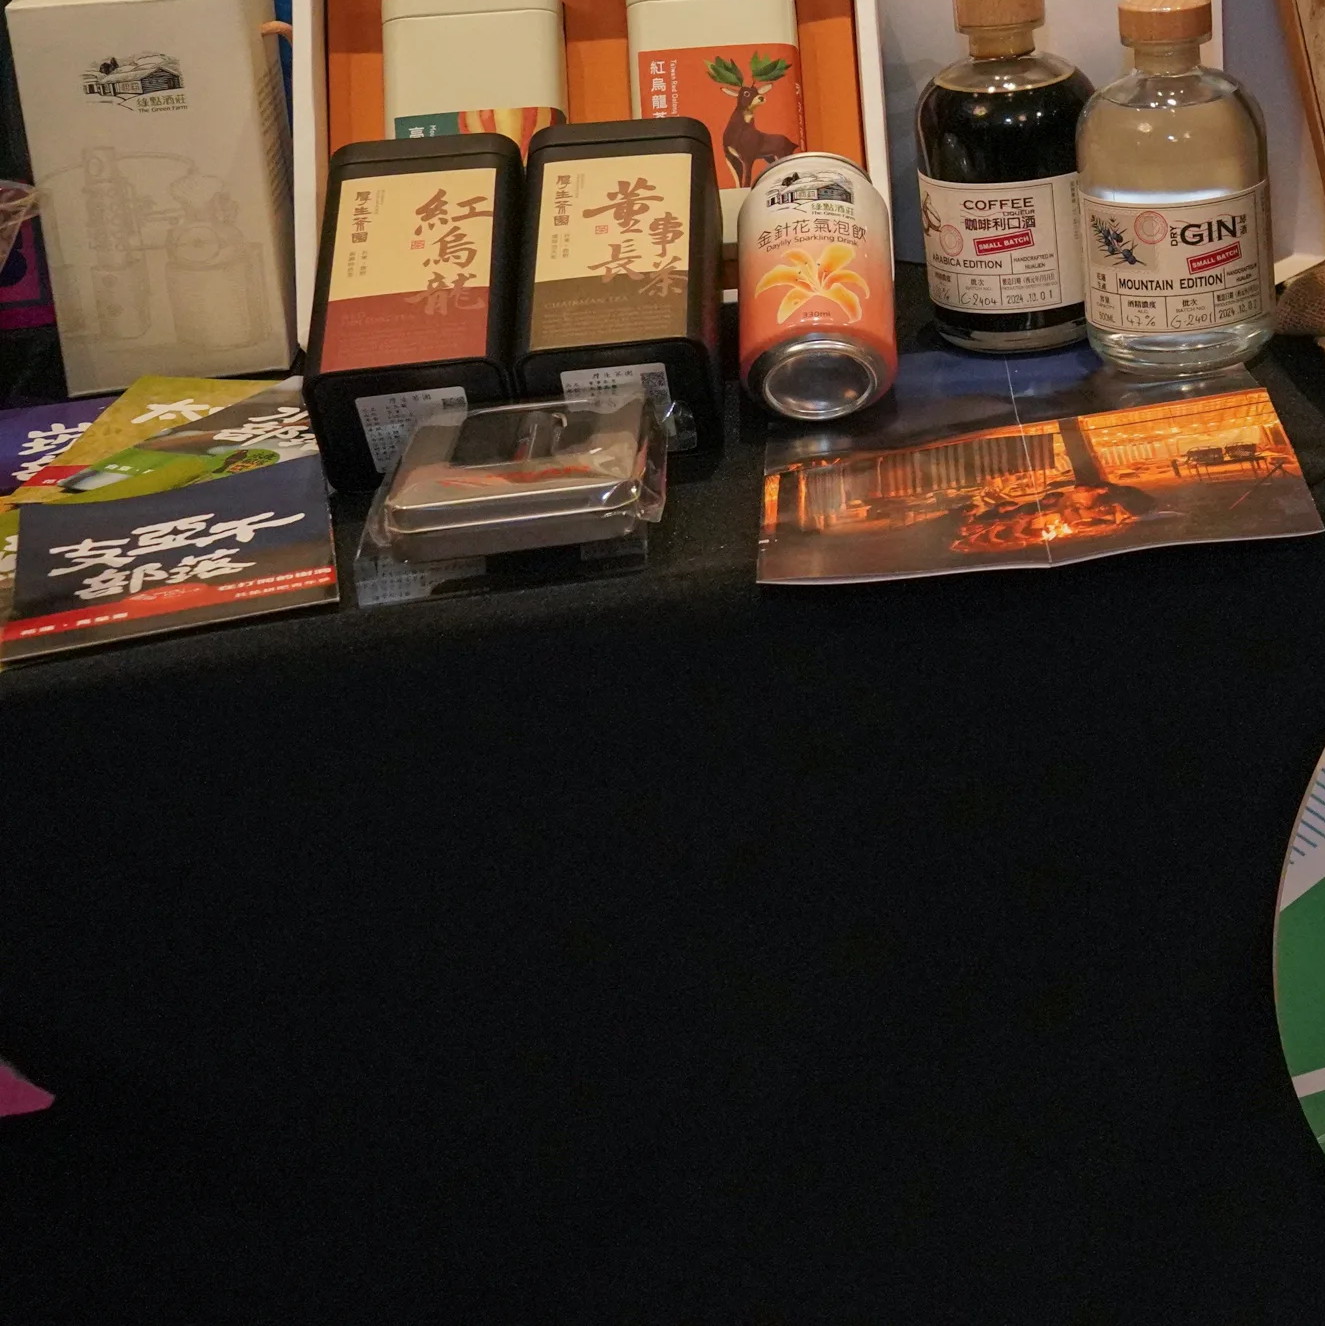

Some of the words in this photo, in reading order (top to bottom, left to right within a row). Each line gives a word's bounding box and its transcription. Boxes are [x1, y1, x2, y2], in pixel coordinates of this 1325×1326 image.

[963, 196, 1035, 211] COFFEE
[964, 216, 1037, 231] 咖啡利口酒
[1179, 215, 1238, 246] GIN
[757, 218, 867, 250] 金針花氣泡飲
[765, 238, 792, 253] Daylily
[794, 233, 835, 243] Sparkling
[836, 236, 859, 247] Drink
[978, 241, 1002, 251] SMALL
[1004, 235, 1030, 247] BATCH
[1170, 225, 1179, 247] DRY
[403, 187, 494, 317] 紅烏龍
[932, 252, 962, 268] ARABICA
[963, 259, 1003, 269] EDITION
[1191, 258, 1216, 269] SMALL
[1216, 249, 1240, 262] BATCH
[1118, 277, 1174, 292] MOUNTAIN
[1179, 274, 1224, 290] EDITION
[74, 548, 257, 601] 部落
